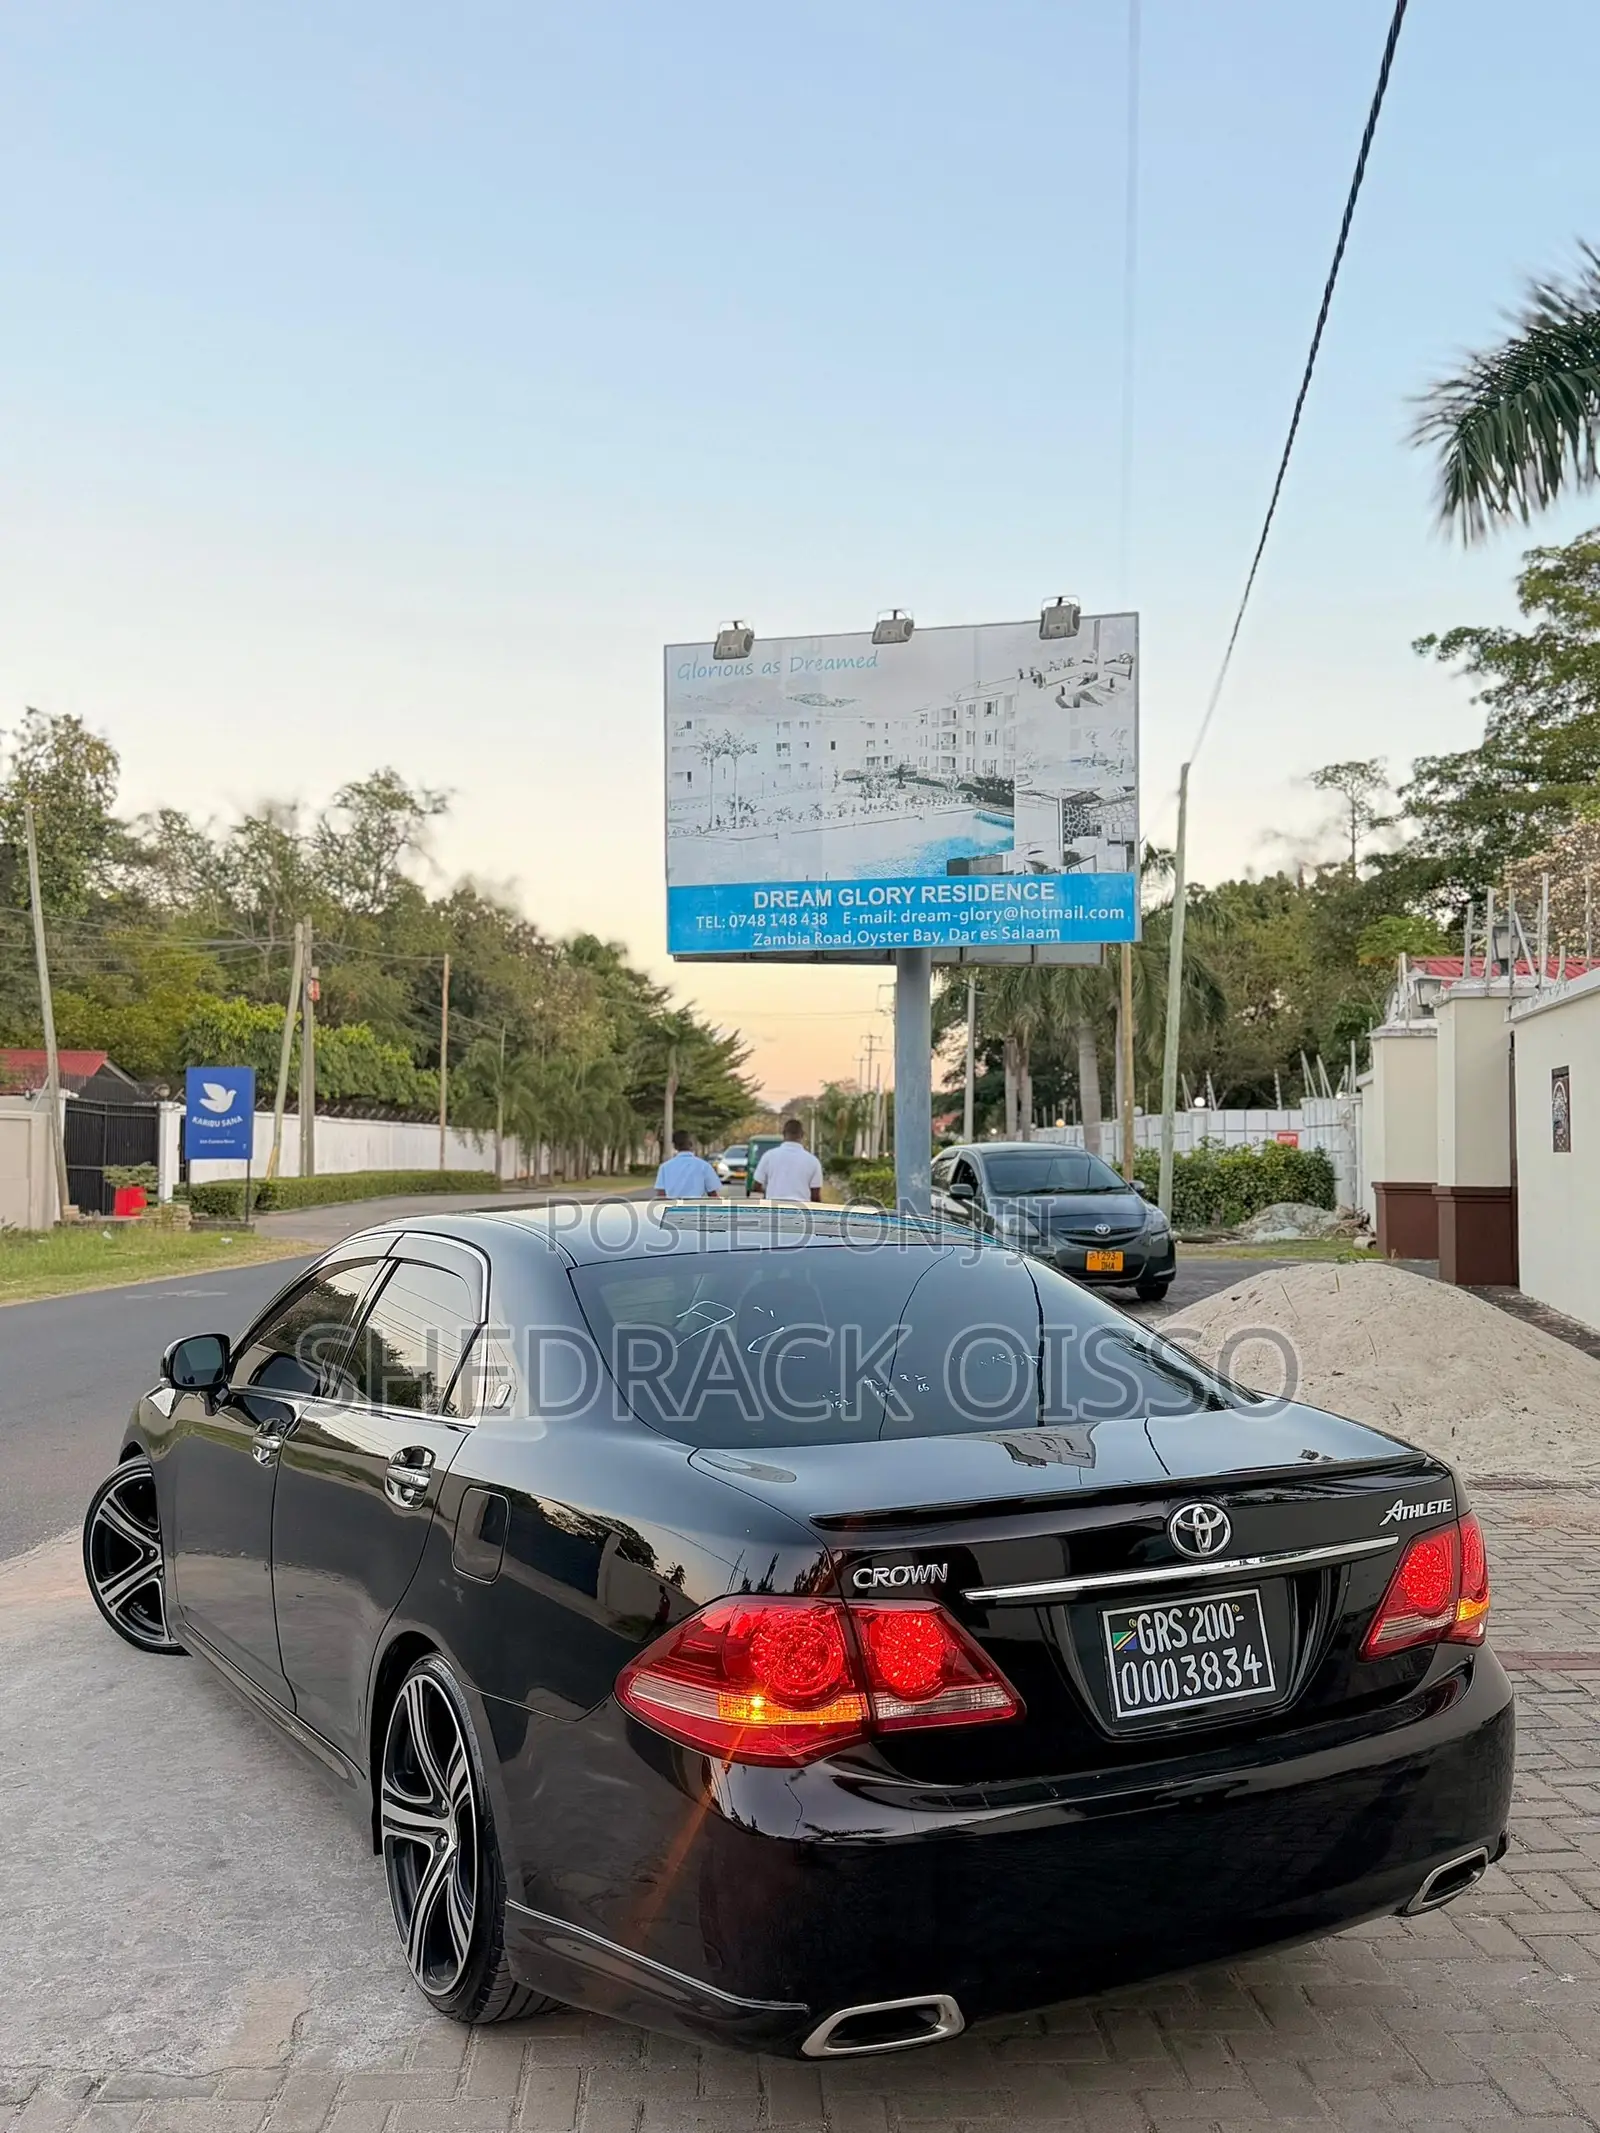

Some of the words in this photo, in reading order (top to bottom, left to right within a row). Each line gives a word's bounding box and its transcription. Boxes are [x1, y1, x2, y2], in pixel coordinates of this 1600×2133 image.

[676, 652, 754, 681] Glorious
[761, 660, 781, 675] as
[789, 650, 880, 674] Dreamed
[753, 888, 832, 909] DREAM
[838, 886, 916, 907] GLORY
[921, 882, 1055, 904] RESIDENCE
[695, 915, 726, 930] TEL:
[728, 913, 767, 929] 0748
[770, 912, 798, 928] 148
[800, 911, 828, 926] 438
[843, 909, 898, 926] E-mail:
[900, 905, 1125, 925] dream-glory@hotmail.com
[753, 931, 811, 947] Zambia
[912, 929, 945, 945] Bay,
[949, 928, 977, 942] Dar
[980, 929, 999, 941] es
[1001, 926, 1061, 941] Salaam
[221, 1115, 244, 1128] SANA
[1379, 1498, 1453, 1526] ATHLETE
[852, 1562, 948, 1589] CROWN
[1121, 1644, 1263, 1706] 0003834
